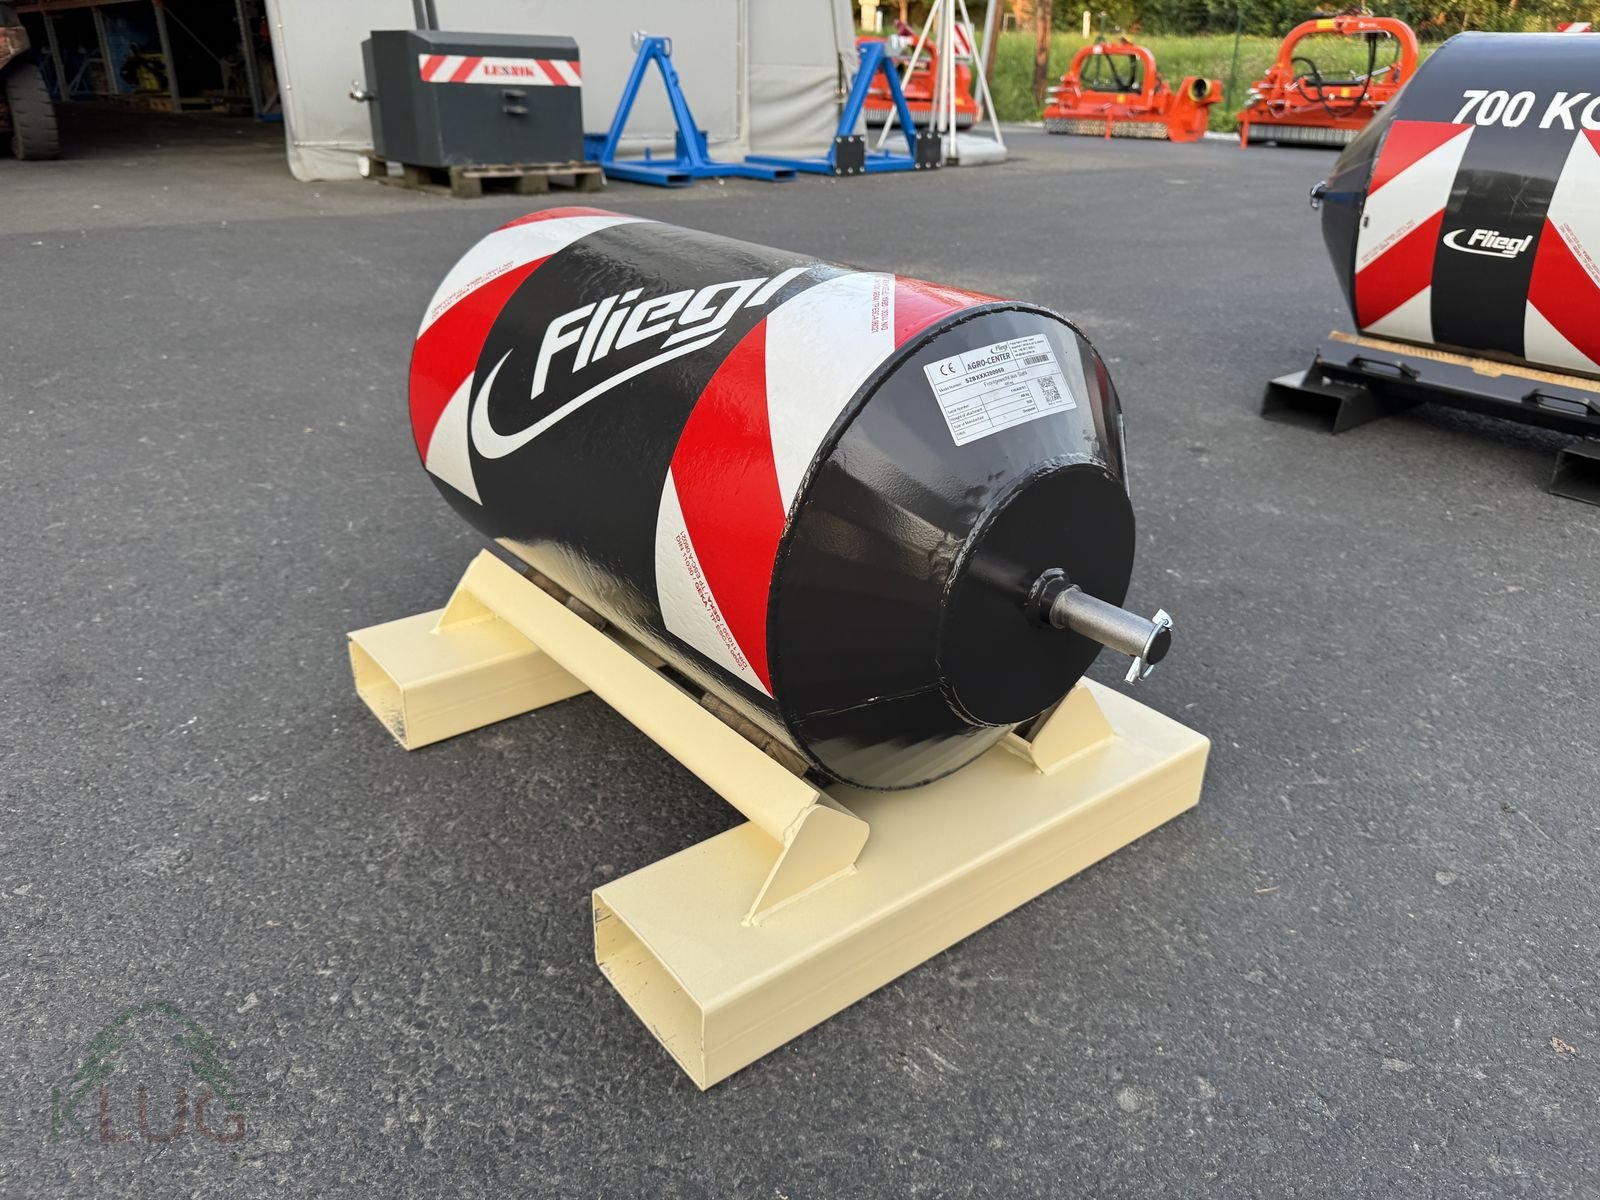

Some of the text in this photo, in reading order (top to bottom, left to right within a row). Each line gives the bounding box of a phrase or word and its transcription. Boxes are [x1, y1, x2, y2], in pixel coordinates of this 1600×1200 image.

[1452, 89, 1536, 128] 700
[1467, 228, 1533, 254] Fliegl
[530, 267, 811, 400] Fliegl
[966, 352, 1010, 371] AGRO-CENTER
[680, 530, 690, 553] 06021
[688, 553, 701, 578] ESC-A
[698, 579, 706, 591] TP
[675, 535, 684, 550] DIN
[682, 553, 694, 575] 11030
[693, 581, 708, 607] GEKA
[709, 614, 717, 623] TP
[715, 624, 731, 649] ESC-A
[729, 649, 744, 671] 06021
[706, 596, 721, 621] GEKA
[721, 627, 738, 650] 11030
[736, 652, 747, 667] DIN
